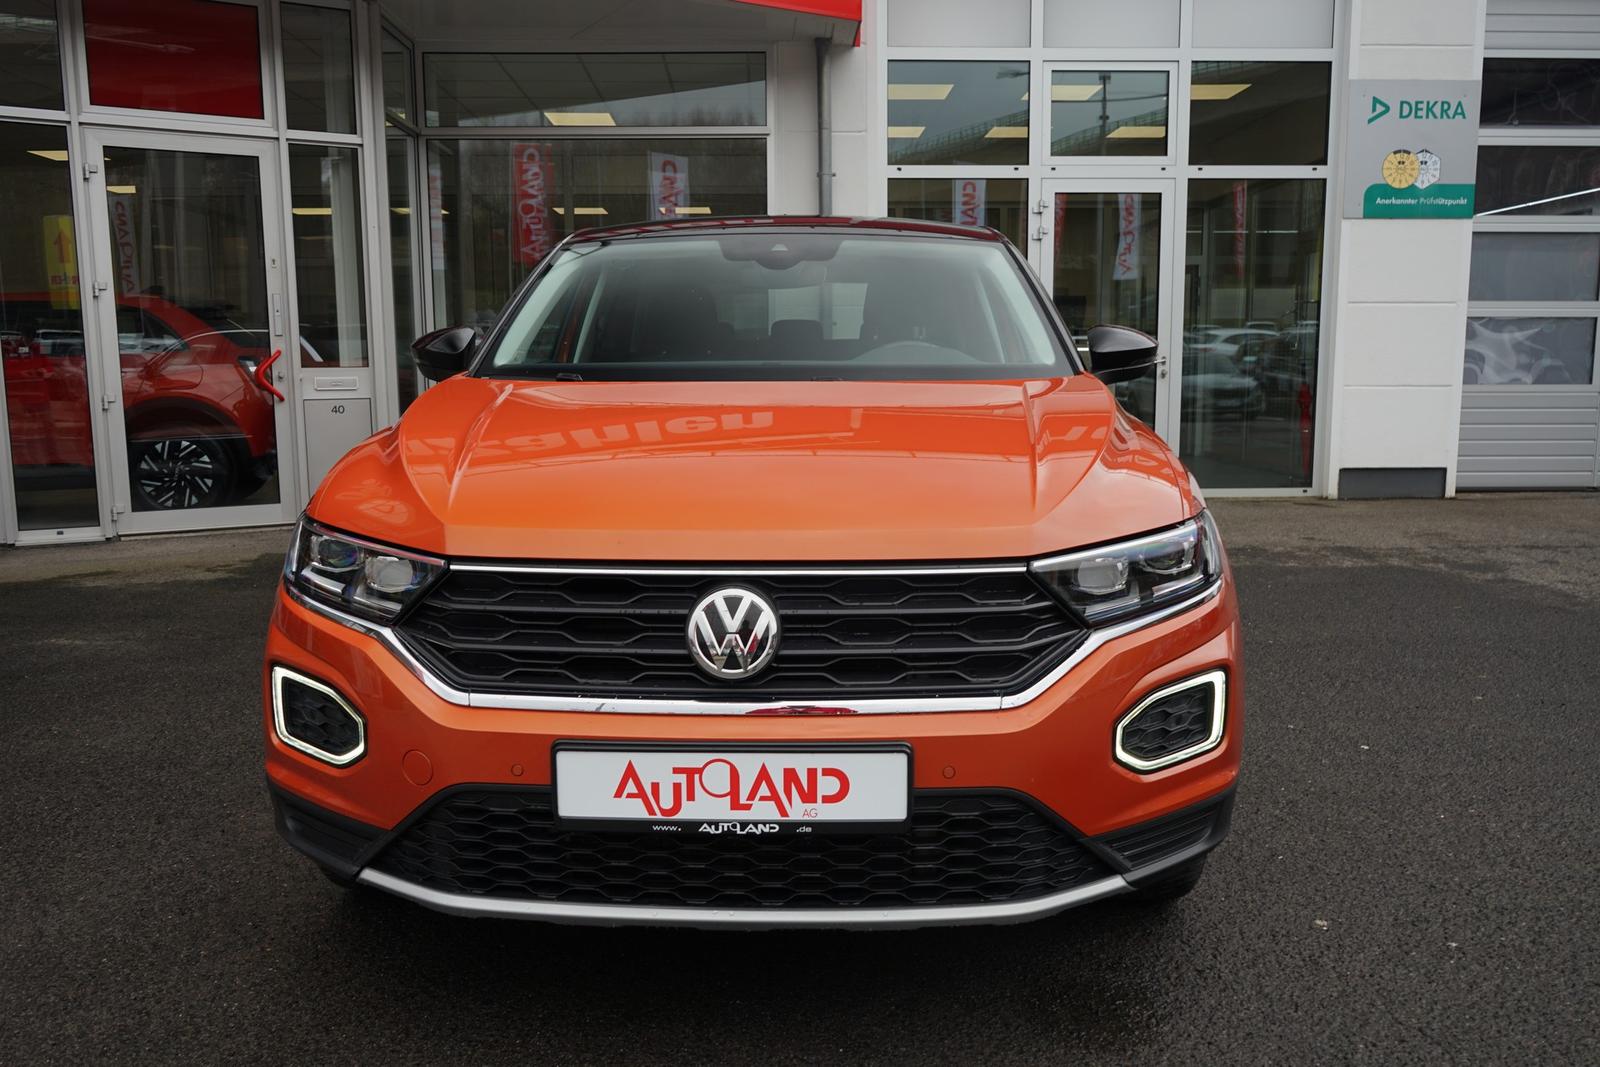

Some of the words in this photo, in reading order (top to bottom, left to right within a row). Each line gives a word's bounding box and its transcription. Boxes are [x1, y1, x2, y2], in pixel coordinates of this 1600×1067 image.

[1399, 100, 1467, 119] DEKRA
[1376, 196, 1418, 205] Anerkannter
[331, 405, 345, 414] 40
[688, 588, 777, 679] VW
[613, 758, 850, 818] AUTOLAND
[802, 808, 818, 818] AG
[699, 822, 780, 834] AUTOLAND
